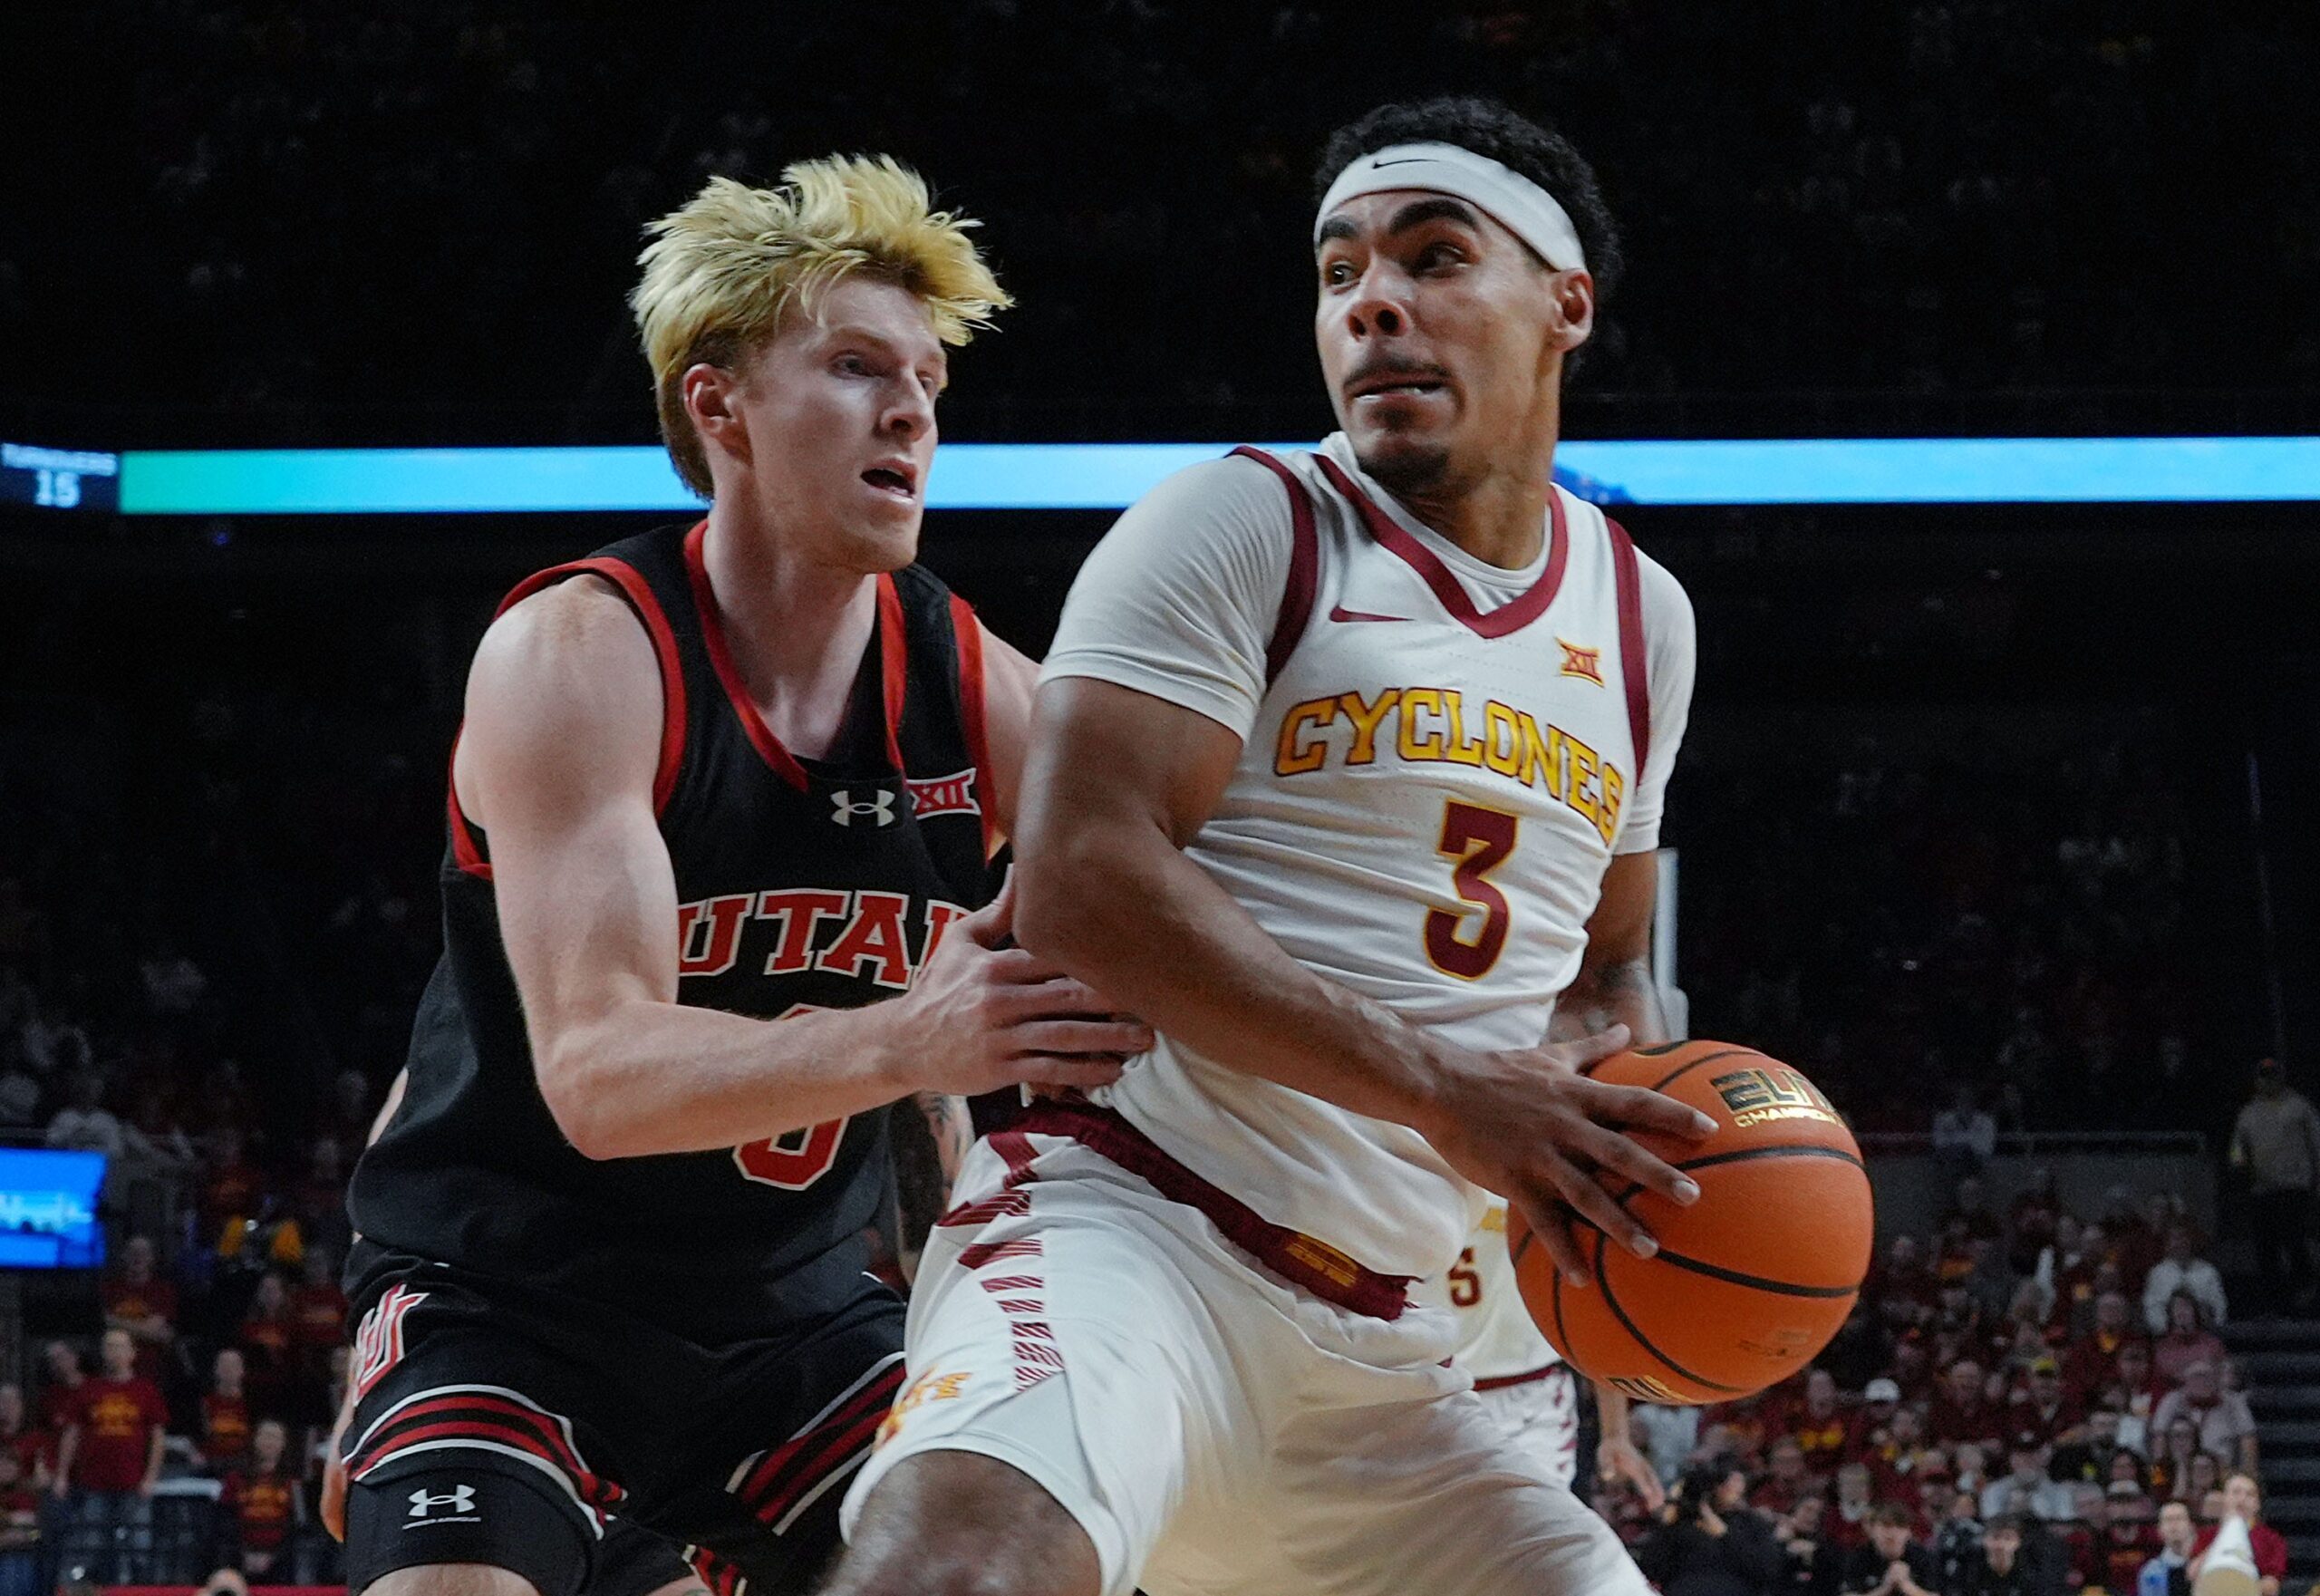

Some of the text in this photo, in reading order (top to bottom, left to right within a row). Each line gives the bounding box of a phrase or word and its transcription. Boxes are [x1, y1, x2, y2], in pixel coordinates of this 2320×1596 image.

[1553, 637, 1604, 687] XII
[907, 768, 981, 819] XII
[1274, 687, 1624, 846] CYCLONES
[1424, 797, 1518, 981] 3
